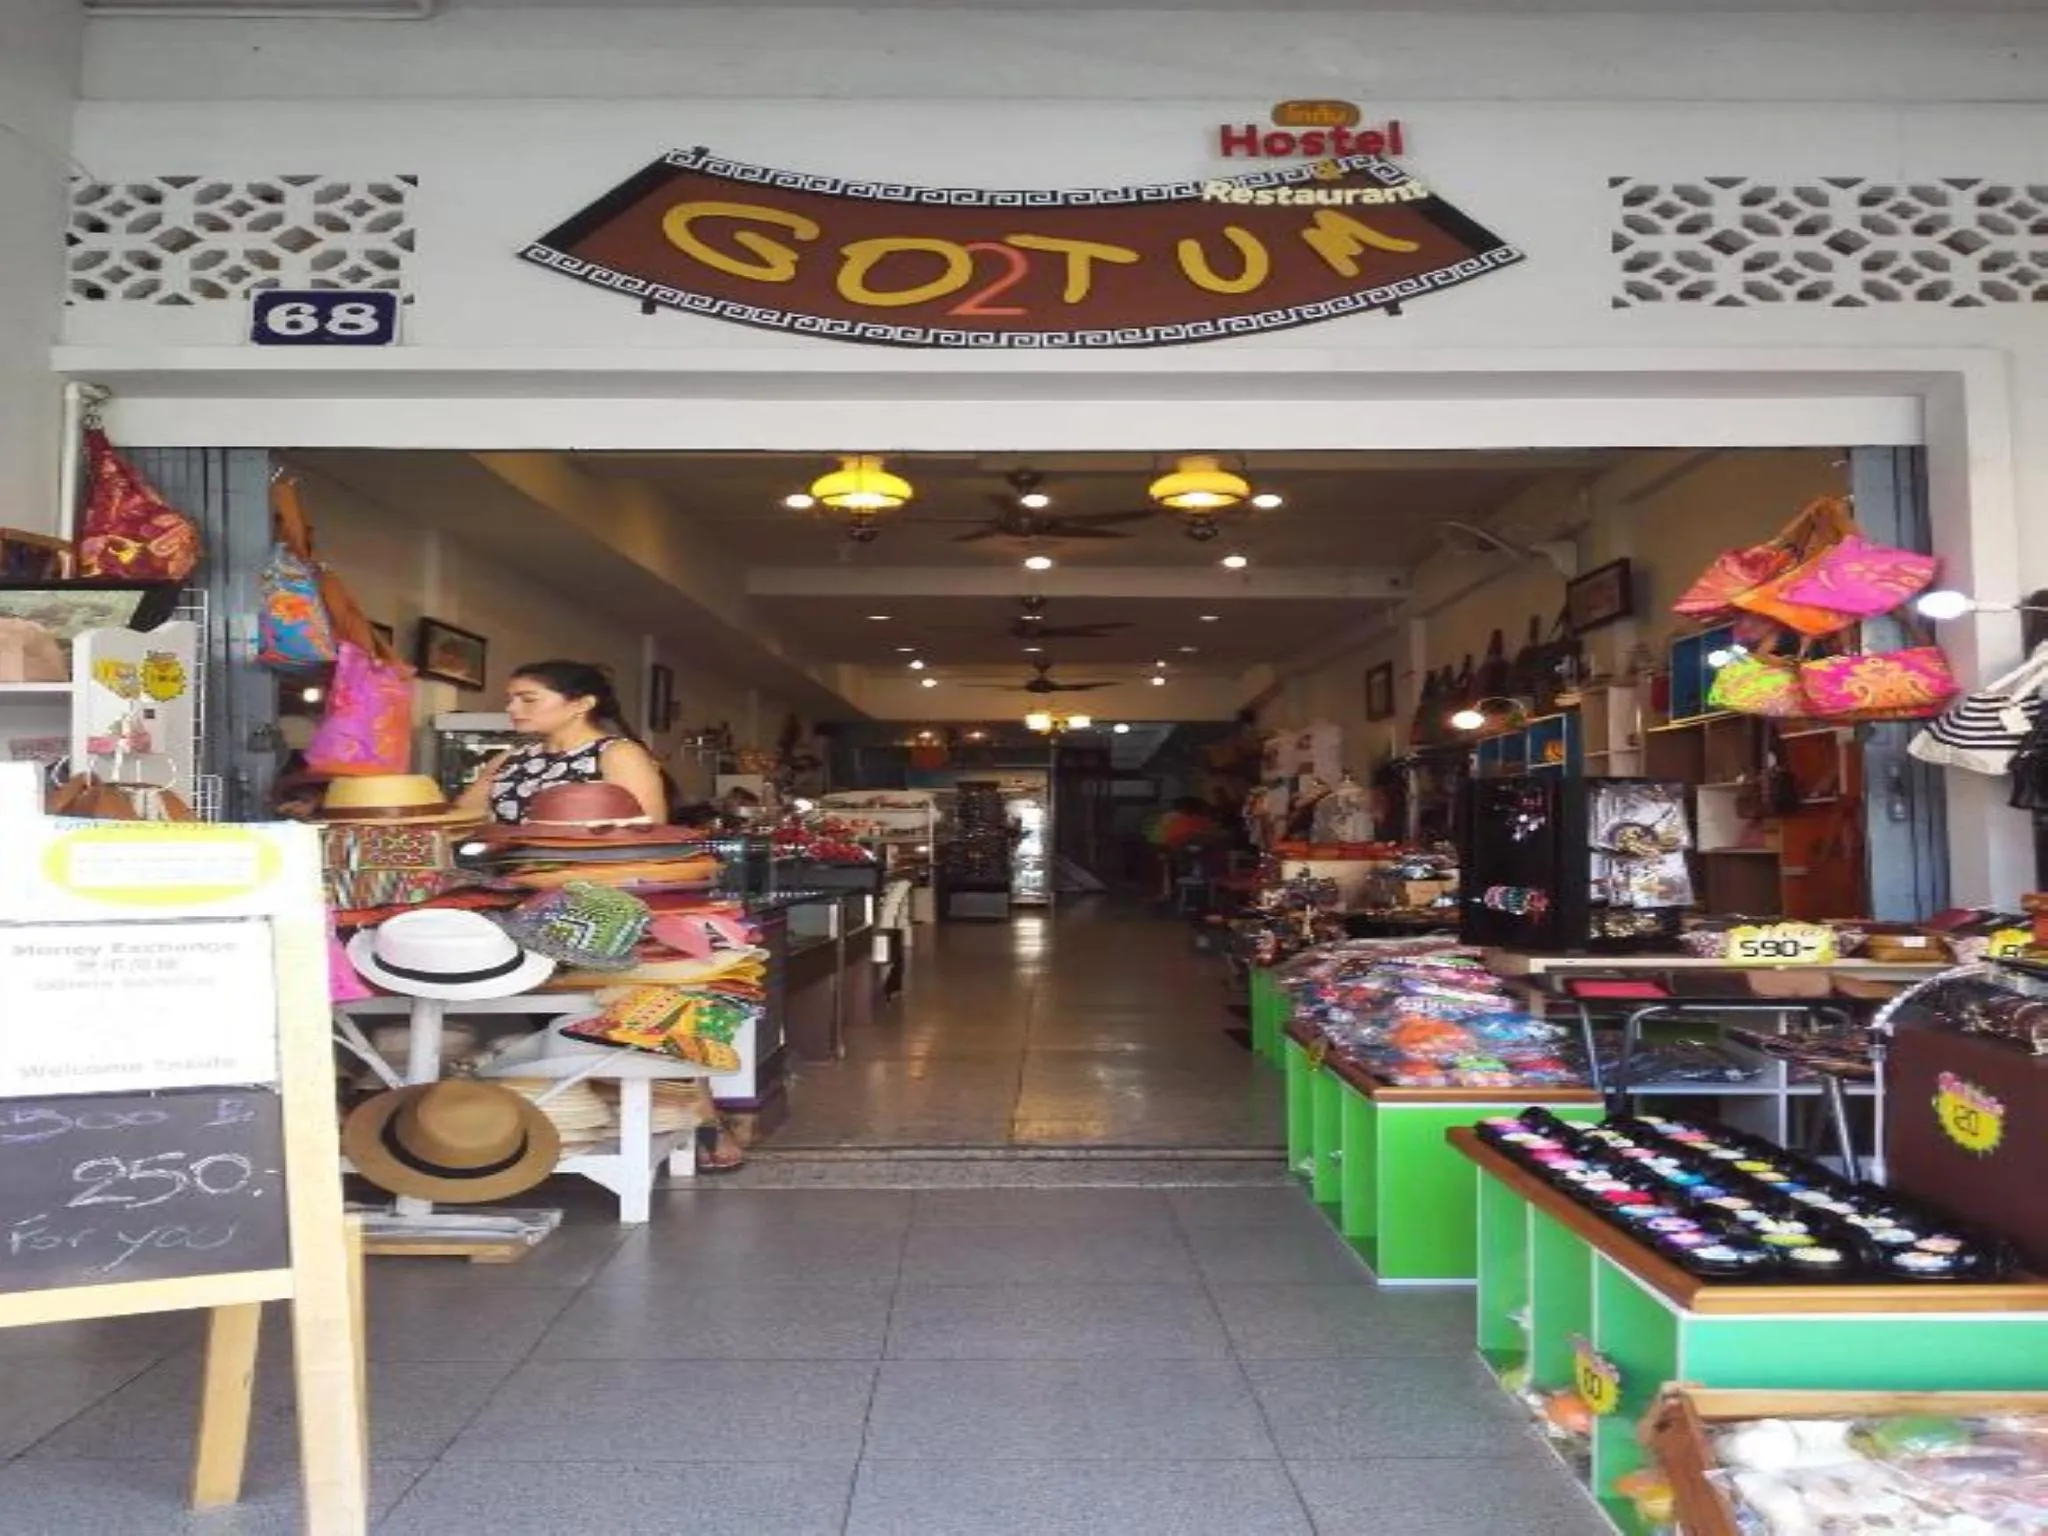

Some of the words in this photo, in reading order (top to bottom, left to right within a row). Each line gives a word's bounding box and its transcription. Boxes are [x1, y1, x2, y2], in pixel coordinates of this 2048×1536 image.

[1219, 120, 1404, 157] Hostel
[1202, 179, 1430, 206] Restaurant
[947, 241, 1029, 316] 2
[266, 302, 379, 336] 68
[90, 1220, 240, 1273] you
